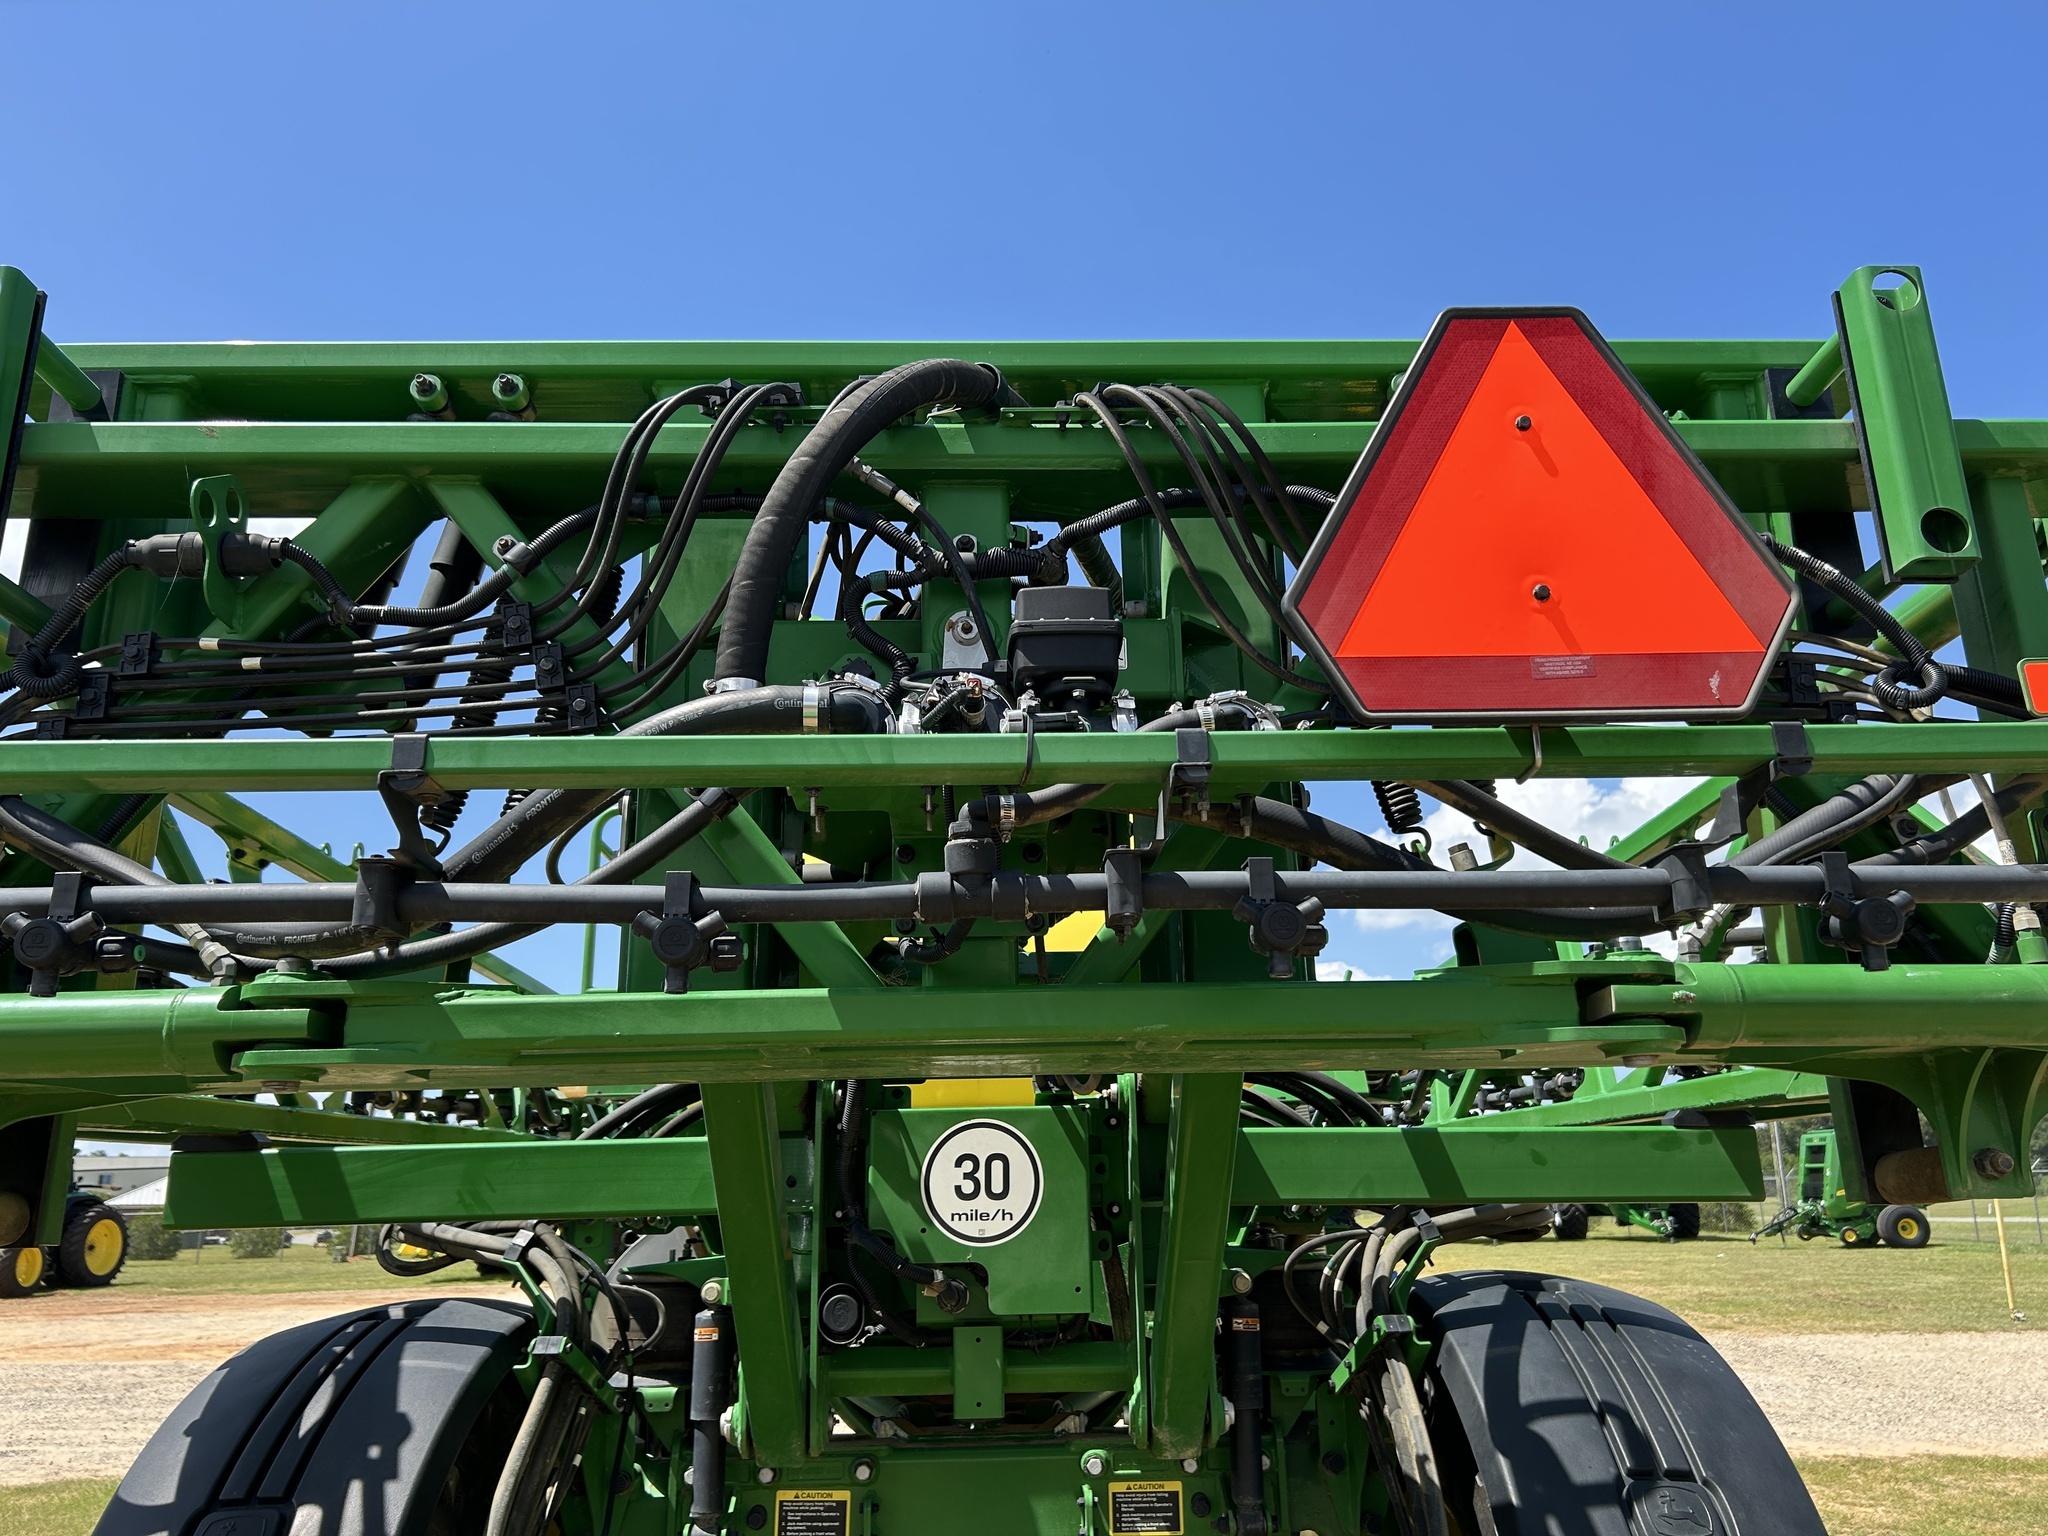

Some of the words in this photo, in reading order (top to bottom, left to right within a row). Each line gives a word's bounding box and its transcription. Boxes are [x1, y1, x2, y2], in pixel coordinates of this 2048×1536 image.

[774, 698, 828, 710] Continal
[471, 825, 512, 865] Continental
[236, 933, 271, 944] Continental
[284, 934, 317, 944] FRONTIER
[954, 1153, 1010, 1201] 30
[951, 1209, 1013, 1221] mile/h
